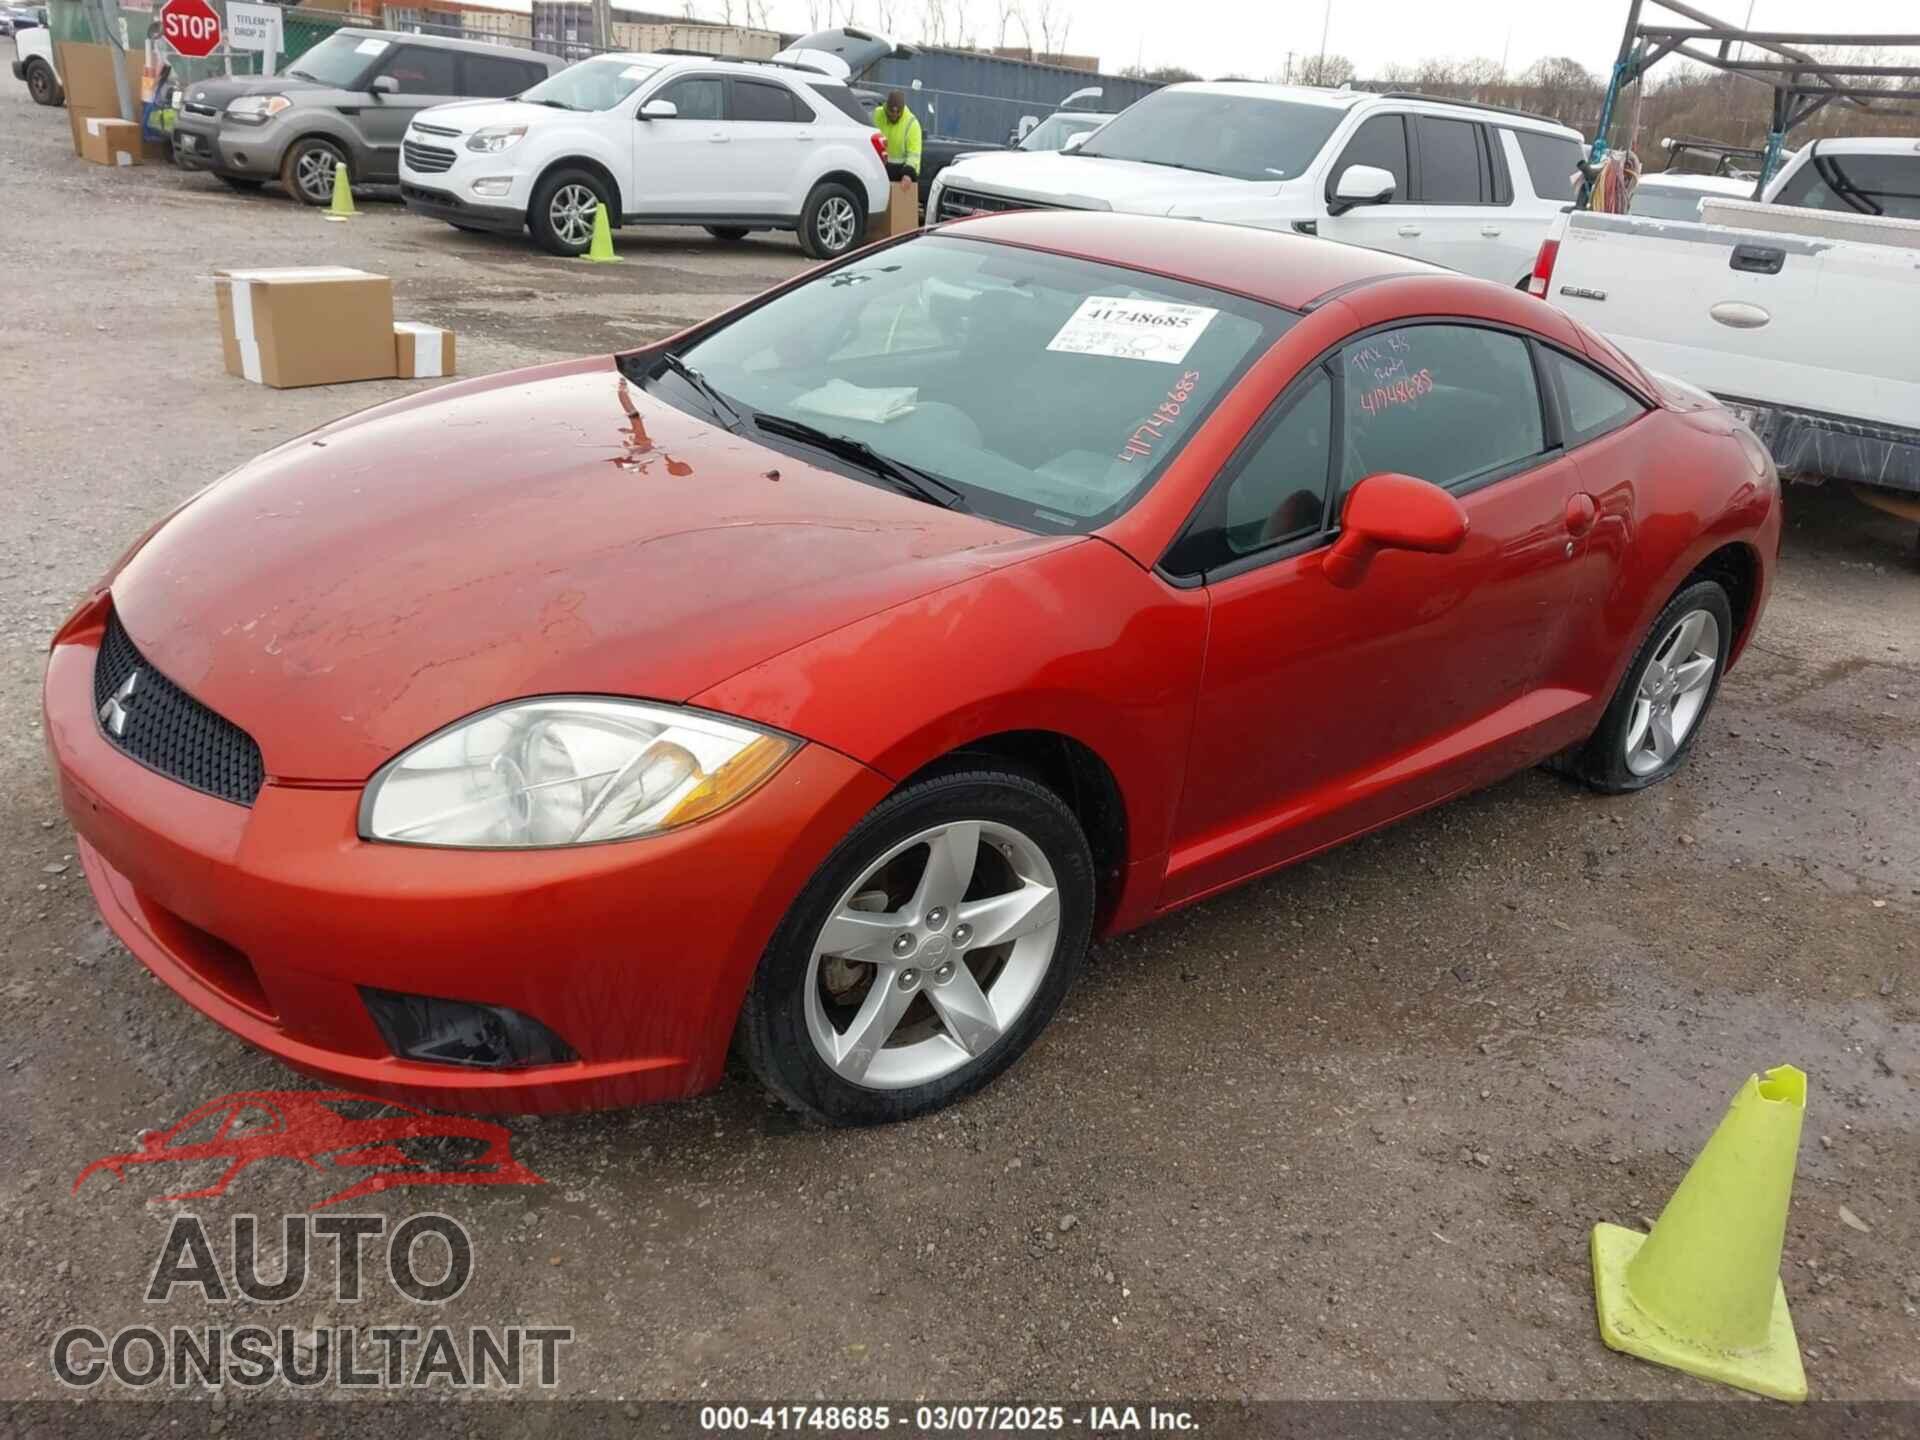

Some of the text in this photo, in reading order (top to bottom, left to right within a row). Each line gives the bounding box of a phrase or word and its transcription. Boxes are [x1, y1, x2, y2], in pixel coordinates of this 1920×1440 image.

[165, 12, 218, 40] STOP
[1087, 307, 1194, 329] 41748685
[1117, 370, 1200, 464] 41748685
